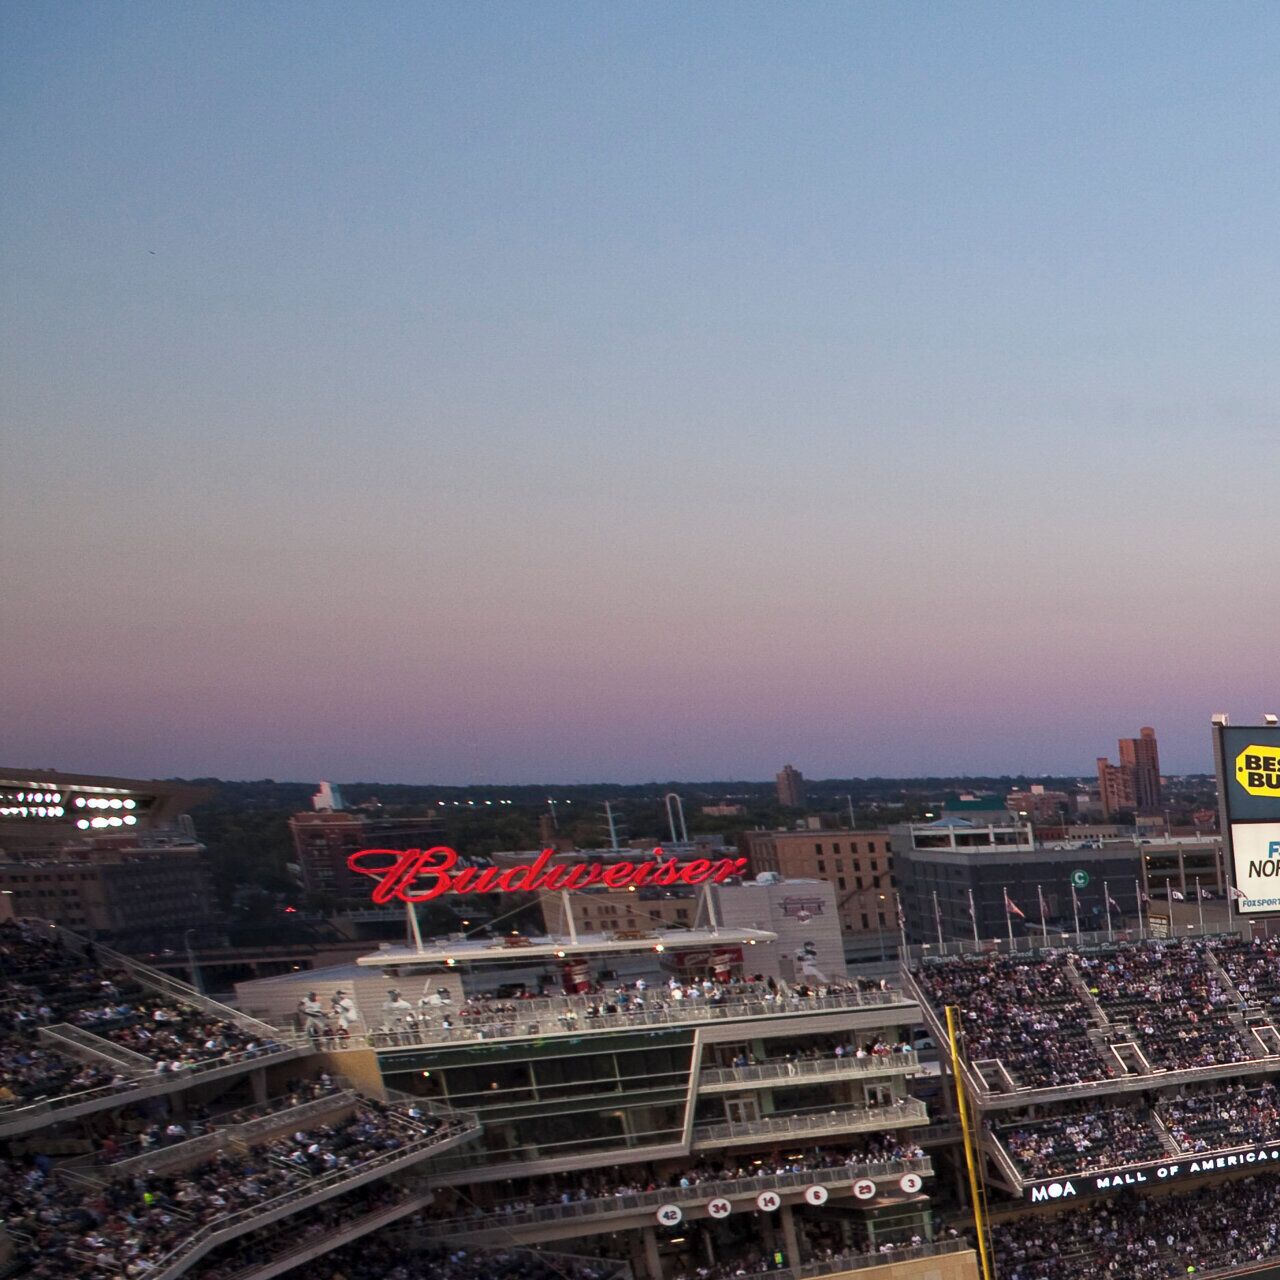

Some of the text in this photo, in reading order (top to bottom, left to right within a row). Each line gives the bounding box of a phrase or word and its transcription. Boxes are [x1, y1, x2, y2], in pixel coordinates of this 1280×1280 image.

[347, 846, 748, 906] Budweiser
[1096, 1172, 1147, 1188] MALL
[1157, 1165, 1178, 1178] OF
[908, 1179, 915, 1188] 3
[858, 1185, 872, 1194] 29
[813, 1191, 820, 1201] 6
[763, 1197, 776, 1207] 14
[712, 1203, 728, 1213] 34
[663, 1210, 678, 1220] 42
